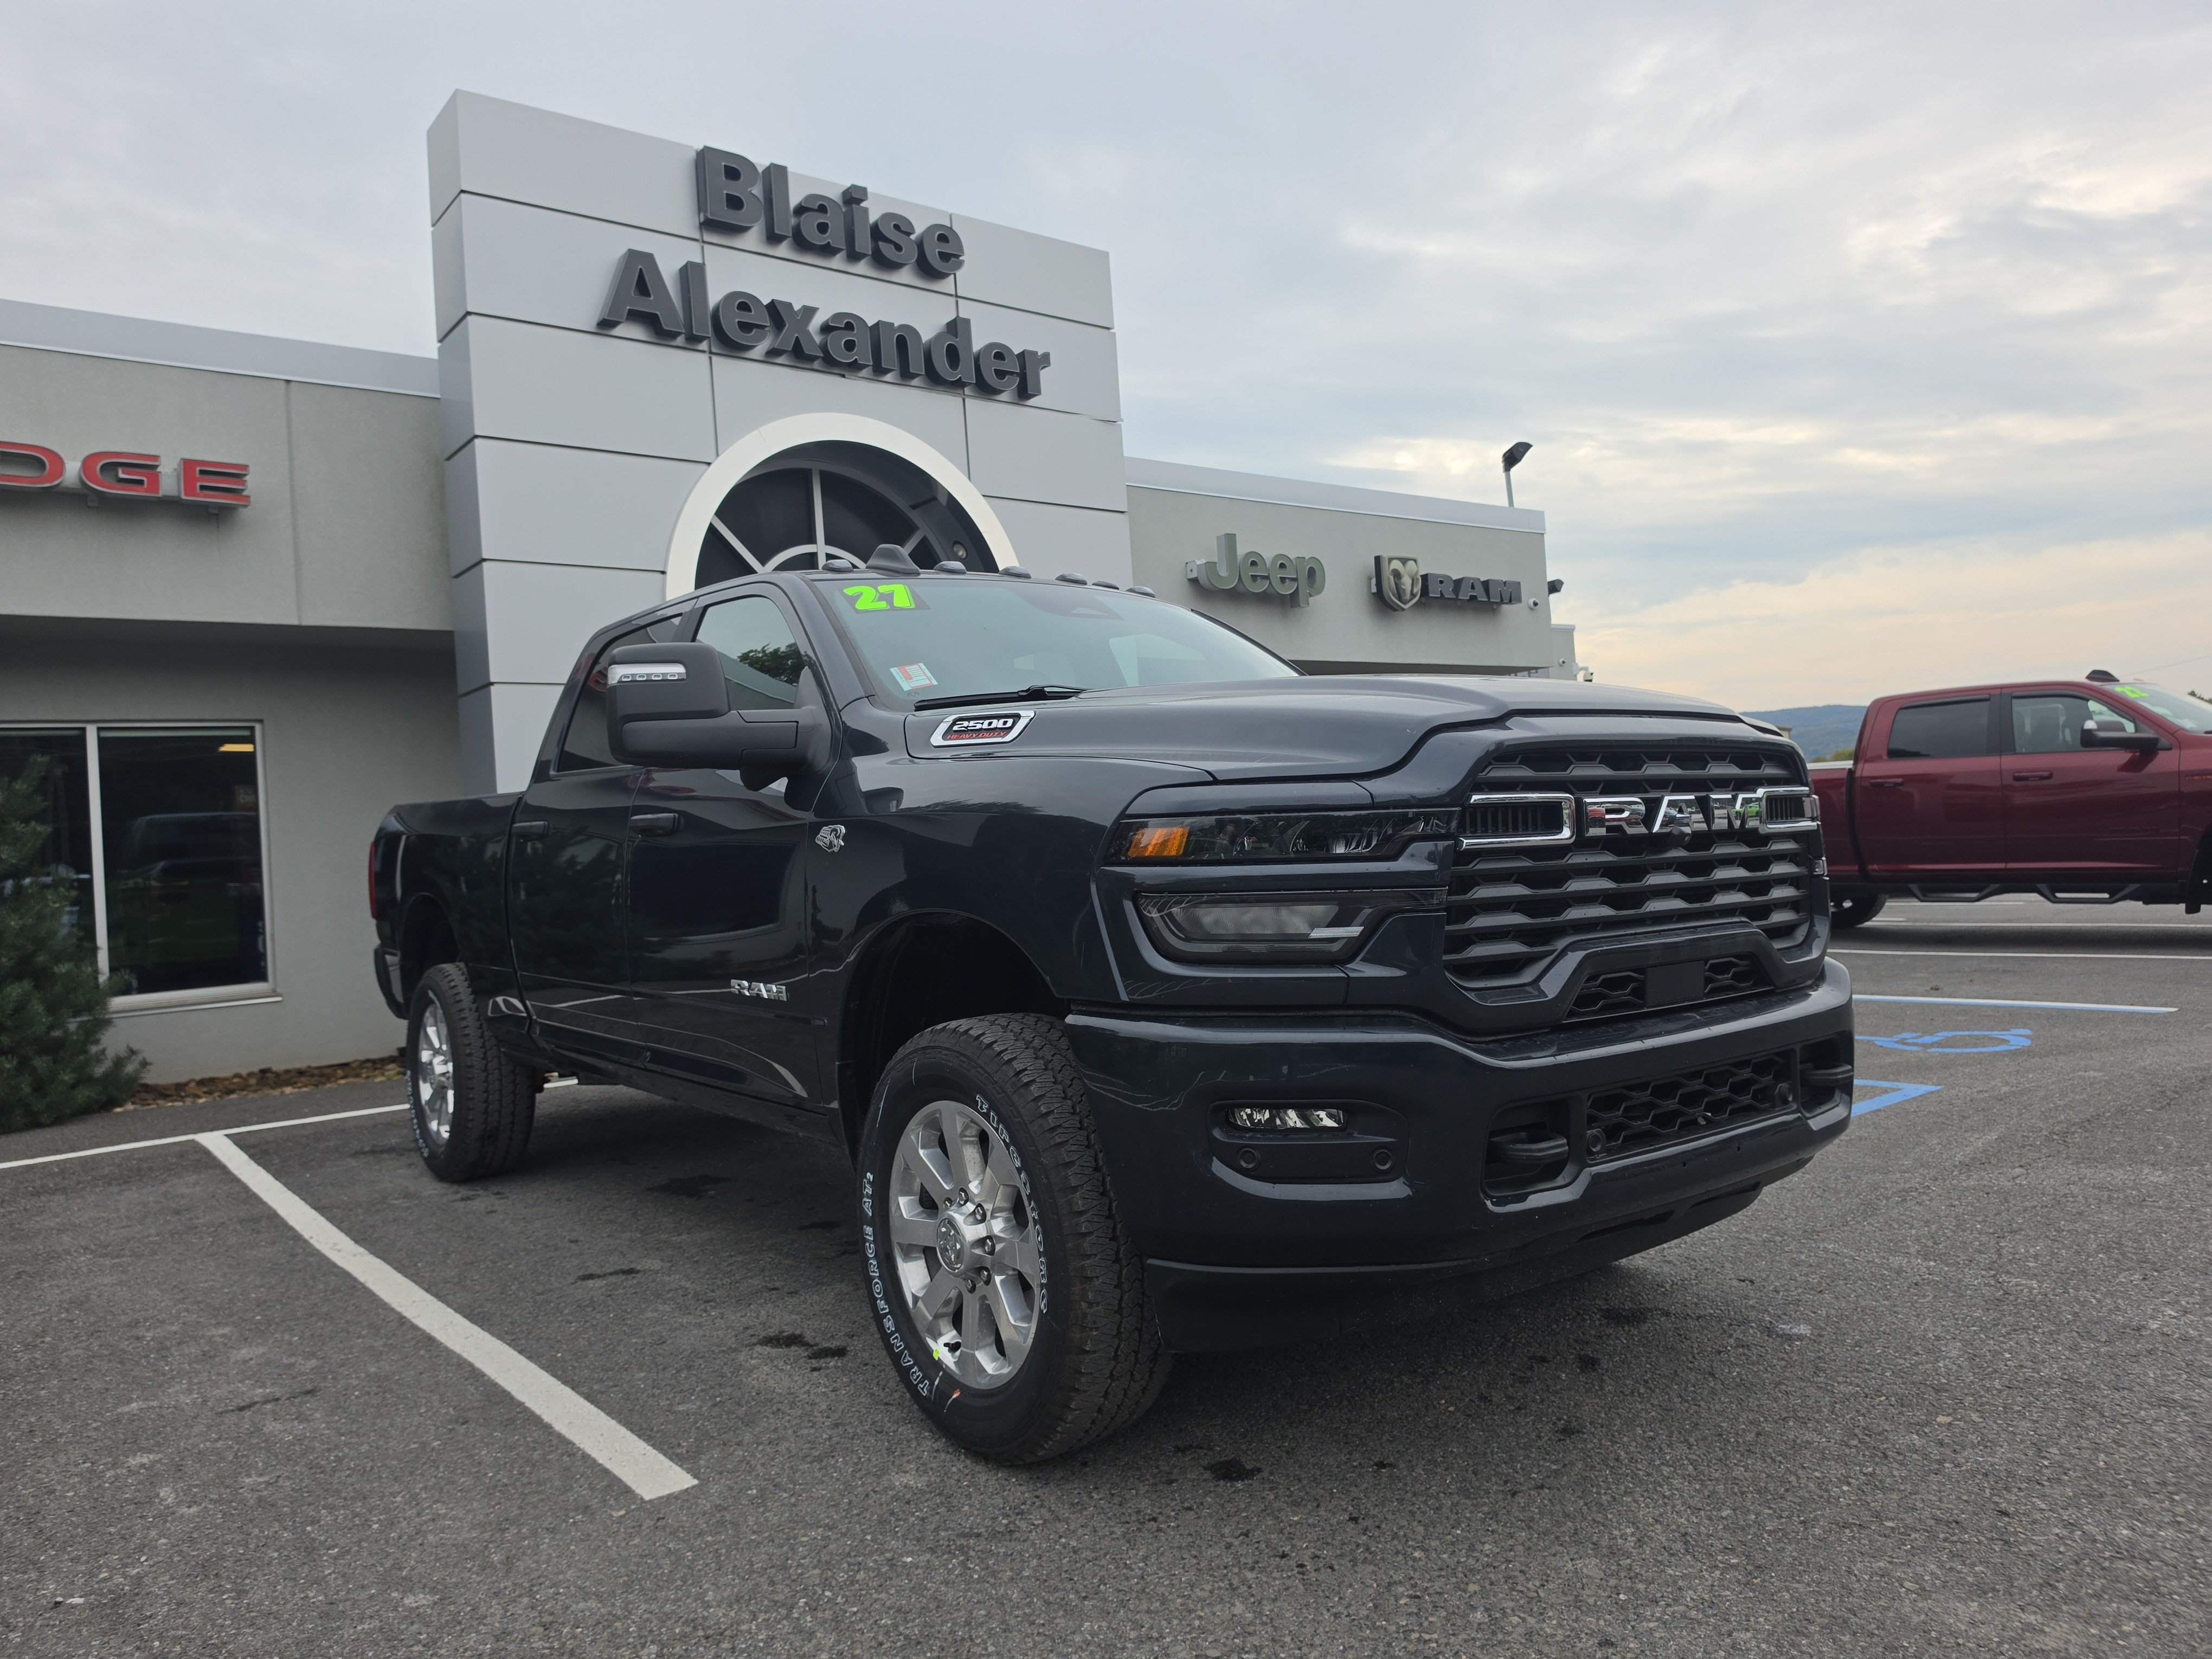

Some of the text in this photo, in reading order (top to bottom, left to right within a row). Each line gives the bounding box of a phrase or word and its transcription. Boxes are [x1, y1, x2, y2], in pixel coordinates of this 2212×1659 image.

[696, 145, 966, 280] Blaise
[596, 248, 1051, 400] Alexander
[1196, 532, 1326, 608] Jeep
[1421, 573, 1522, 605] RAM
[843, 583, 916, 610] 27
[953, 718, 1014, 732] 2500
[1583, 793, 1762, 837] RAM
[731, 979, 788, 1001] RAM
[863, 1224, 930, 1397] TRANSFORCE
